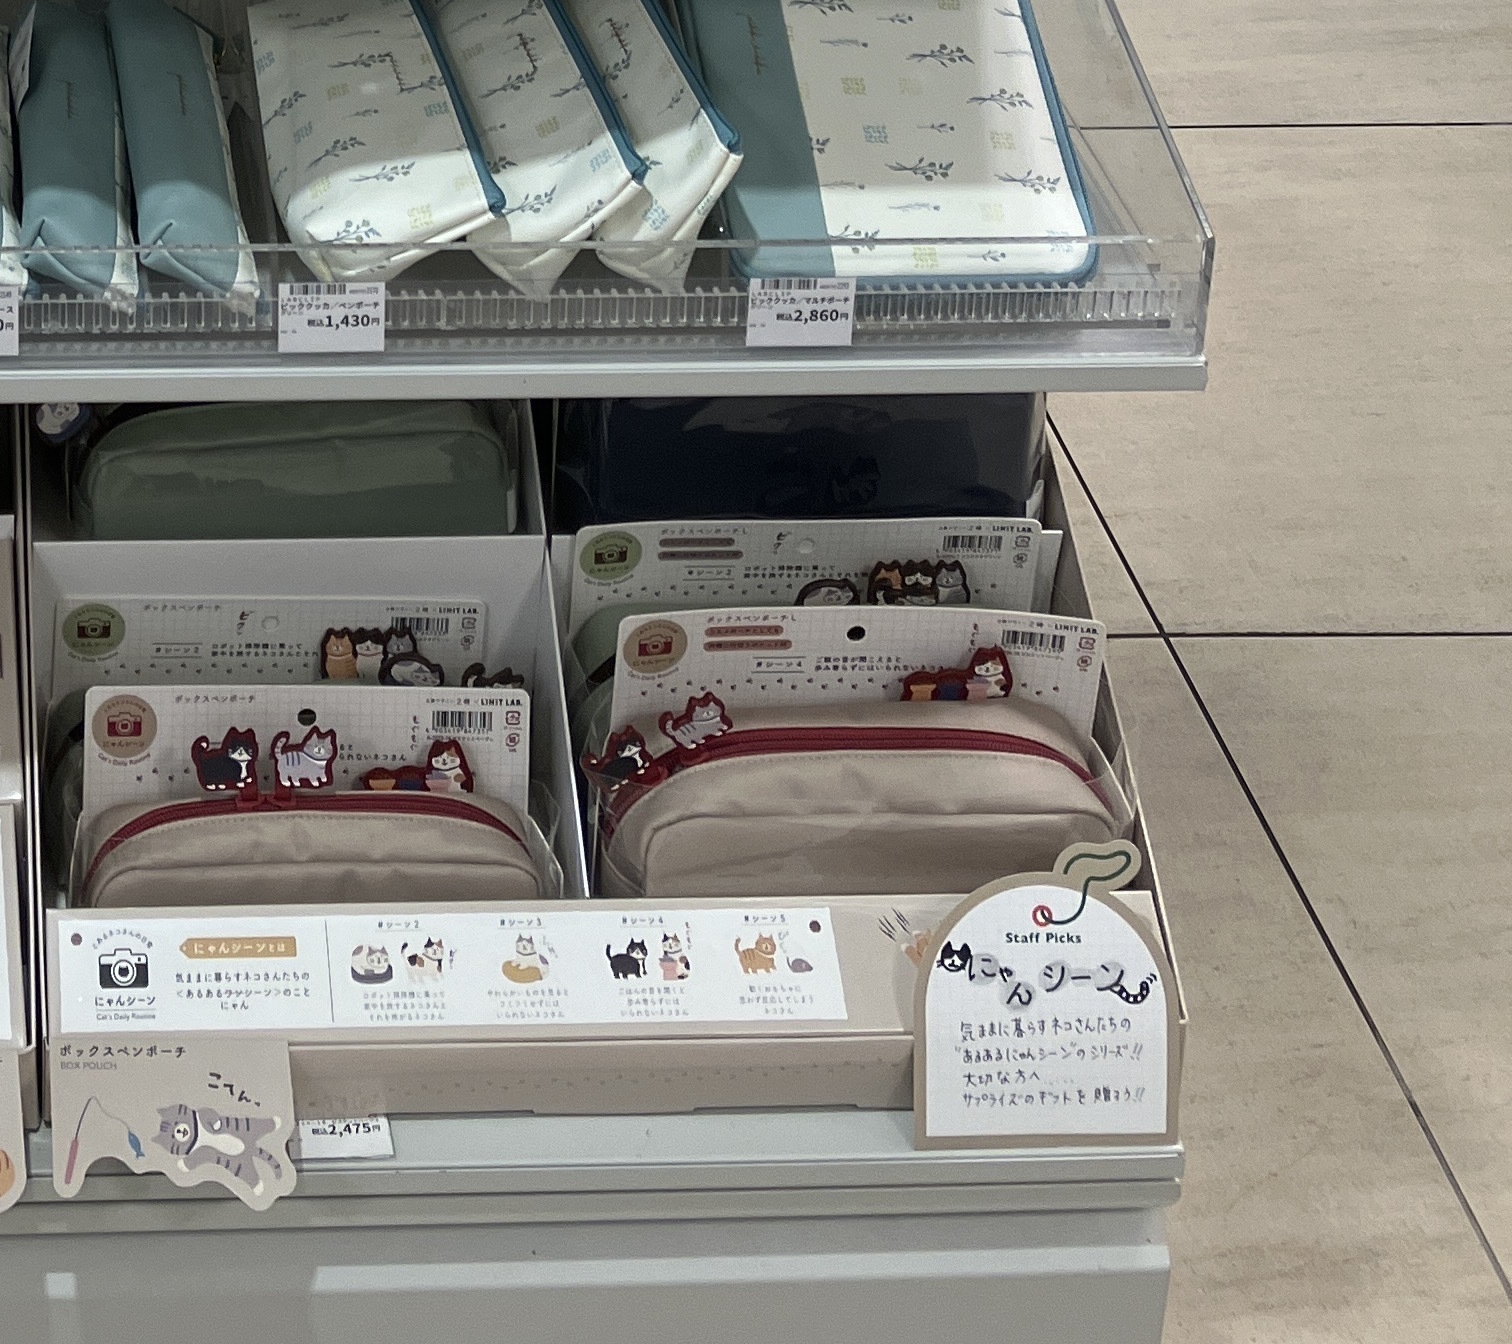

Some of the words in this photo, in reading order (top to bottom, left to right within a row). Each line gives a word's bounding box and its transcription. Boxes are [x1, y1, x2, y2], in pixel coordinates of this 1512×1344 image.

[308, 315, 380, 330] 税込1,430円
[776, 310, 848, 324] 税込2,860円
[480, 698, 503, 706] LIHIT
[1005, 932, 1040, 944] Staff
[1045, 932, 1082, 944] Picks
[193, 942, 286, 954] にゃんシーンとは
[94, 995, 157, 1008] にゃんシーン
[59, 1044, 187, 1059] ボックスペンポーチ
[59, 1060, 81, 1070] BOX
[82, 1061, 118, 1071] POUCH
